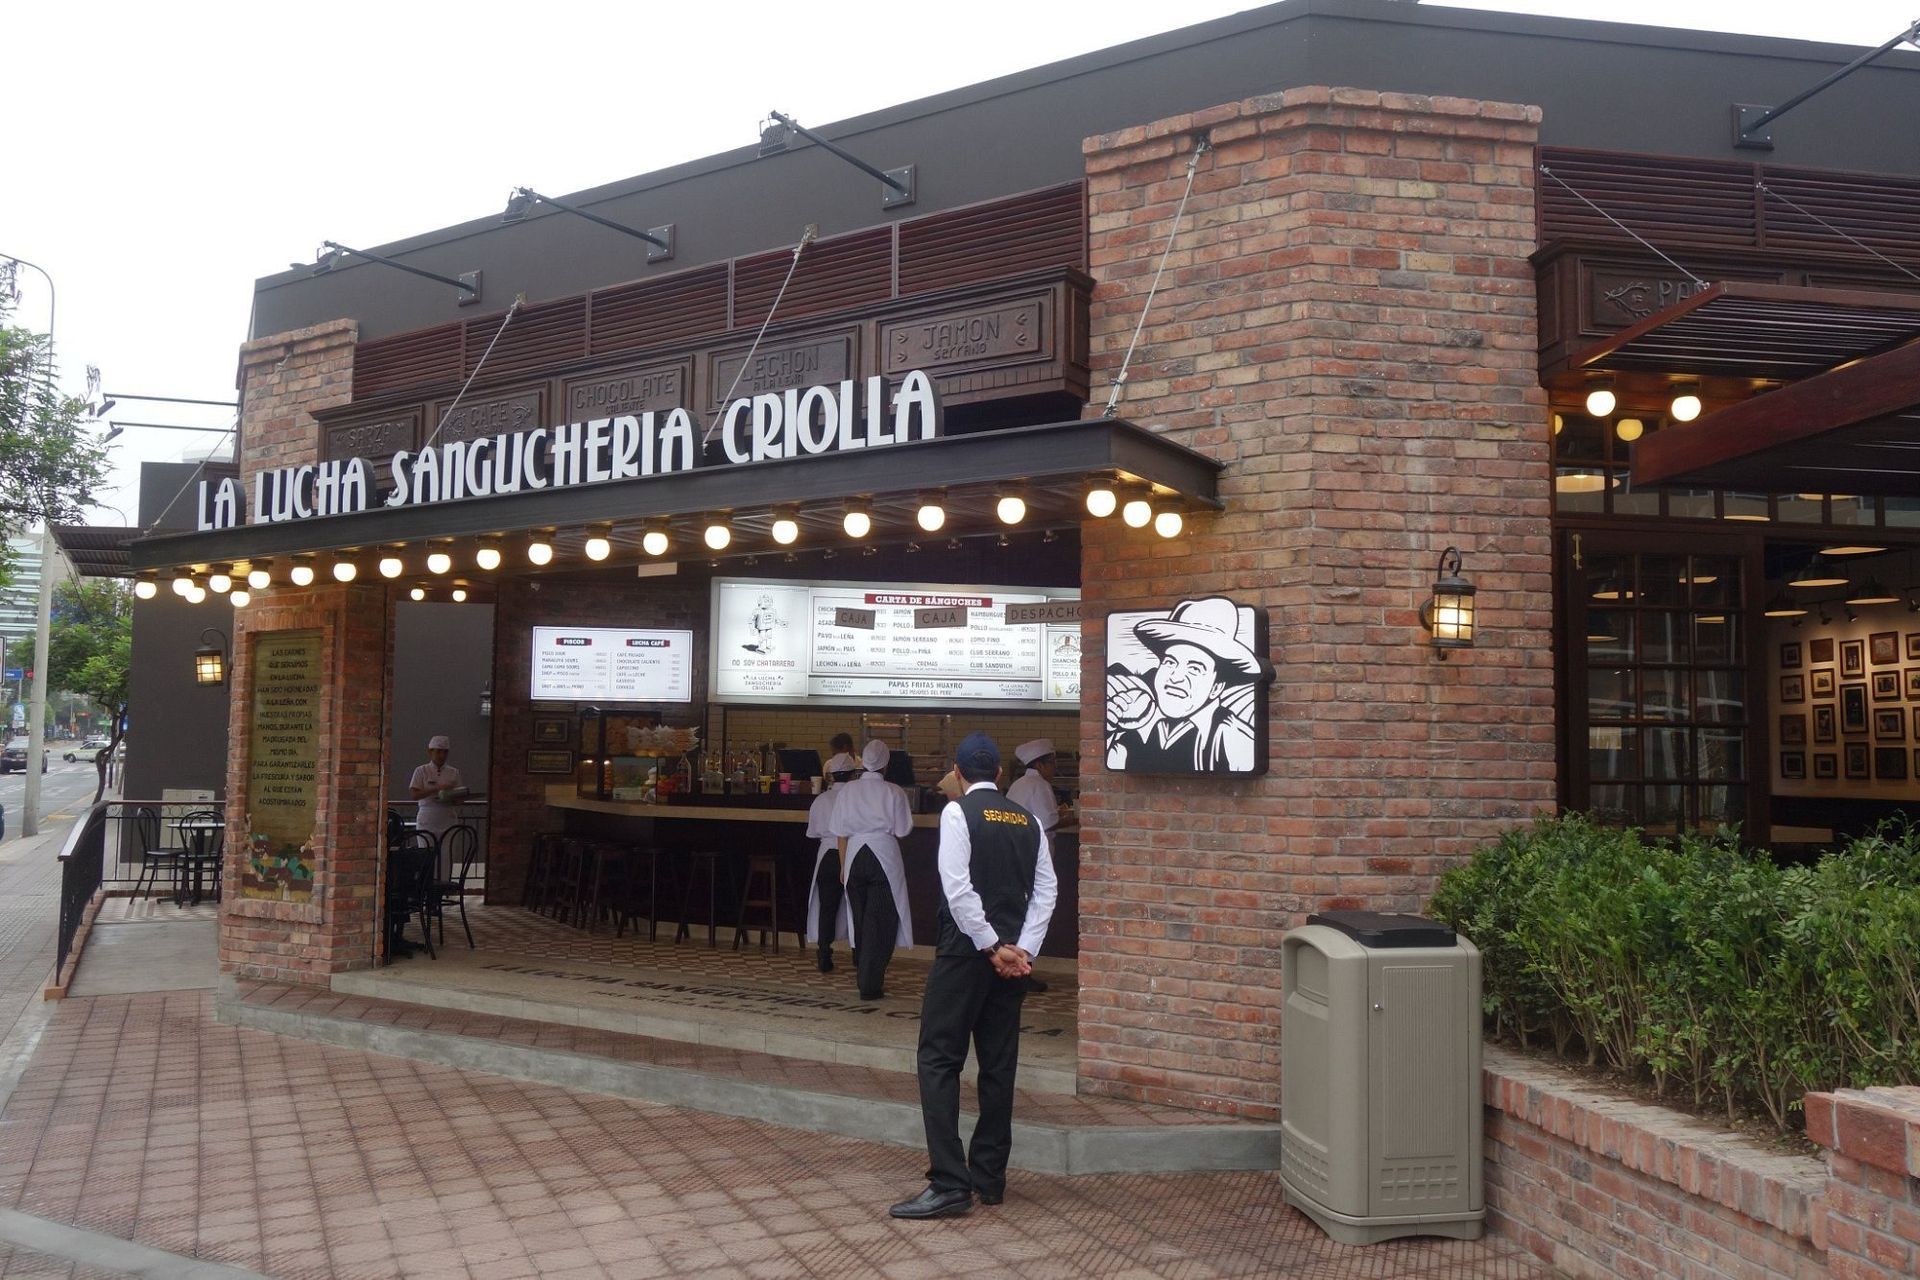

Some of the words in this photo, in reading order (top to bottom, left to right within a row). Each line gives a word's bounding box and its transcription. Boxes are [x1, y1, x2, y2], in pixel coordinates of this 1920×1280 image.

[922, 313, 1000, 350] JAMON
[575, 371, 677, 409] CHOCOLATE
[198, 477, 236, 531] LA
[254, 457, 367, 525] LUCHA
[386, 407, 694, 507] SANGUCHERIA
[722, 369, 936, 464] CRIOLLA
[875, 595, 906, 604] CARTA
[909, 596, 922, 604] DE
[840, 611, 868, 625] CAJA
[922, 612, 956, 624] CAJA
[911, 681, 934, 689] FRITAS
[983, 809, 1029, 826] SEGURIDAD
